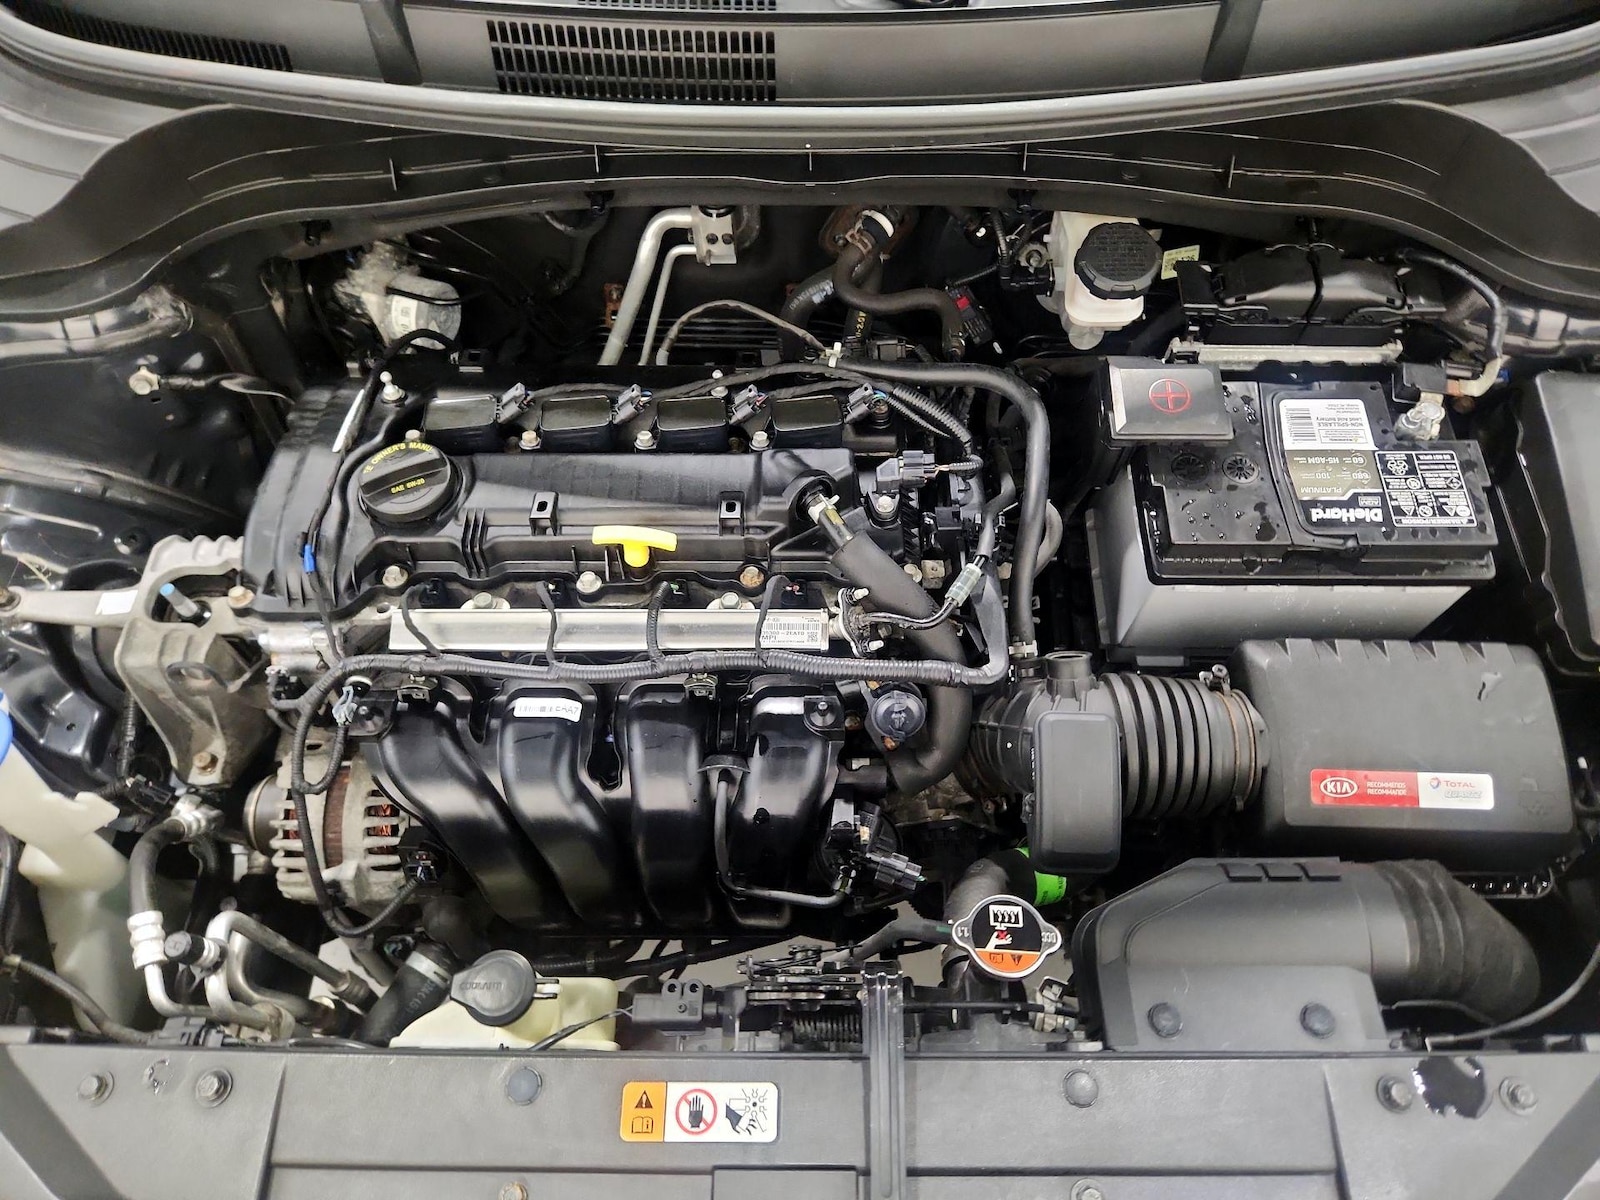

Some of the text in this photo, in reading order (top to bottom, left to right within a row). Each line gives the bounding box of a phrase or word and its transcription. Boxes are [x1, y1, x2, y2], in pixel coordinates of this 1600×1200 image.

[371, 442, 406, 464] OWNER'S
[1352, 456, 1364, 464] 60
[391, 484, 405, 494] SAE
[1311, 508, 1383, 522] DieHard
[1326, 780, 1352, 794] KIA
[1444, 780, 1475, 789] TOTAL
[1367, 788, 1407, 796] RECOMMANDE
